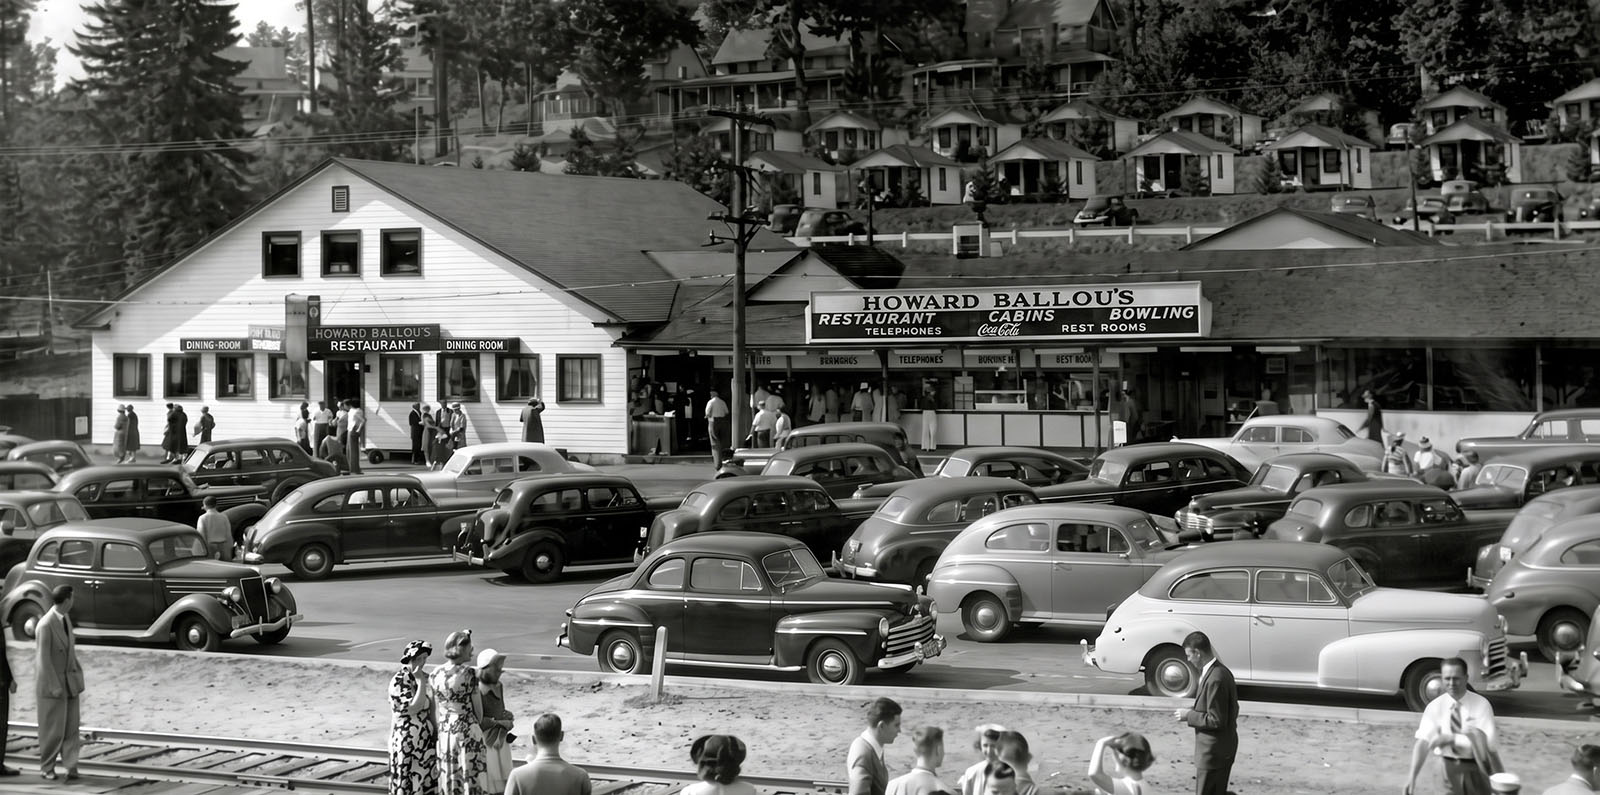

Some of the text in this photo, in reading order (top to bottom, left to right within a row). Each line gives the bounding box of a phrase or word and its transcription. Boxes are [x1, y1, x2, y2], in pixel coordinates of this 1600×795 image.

[862, 287, 1135, 311] HOWARD BALLOU'S
[817, 313, 937, 326] RESTAURANT
[988, 309, 1055, 323] CABINS
[1109, 306, 1195, 321] BOWLING
[315, 326, 432, 339] HOWARD BALLOU'S
[865, 327, 942, 336] TELEPHONES
[1061, 322, 1147, 333] REST ROOMS
[330, 339, 416, 351] RESTAURANT
[446, 340, 505, 350] DINING ROOM
[899, 355, 944, 364] TELEPHONES
